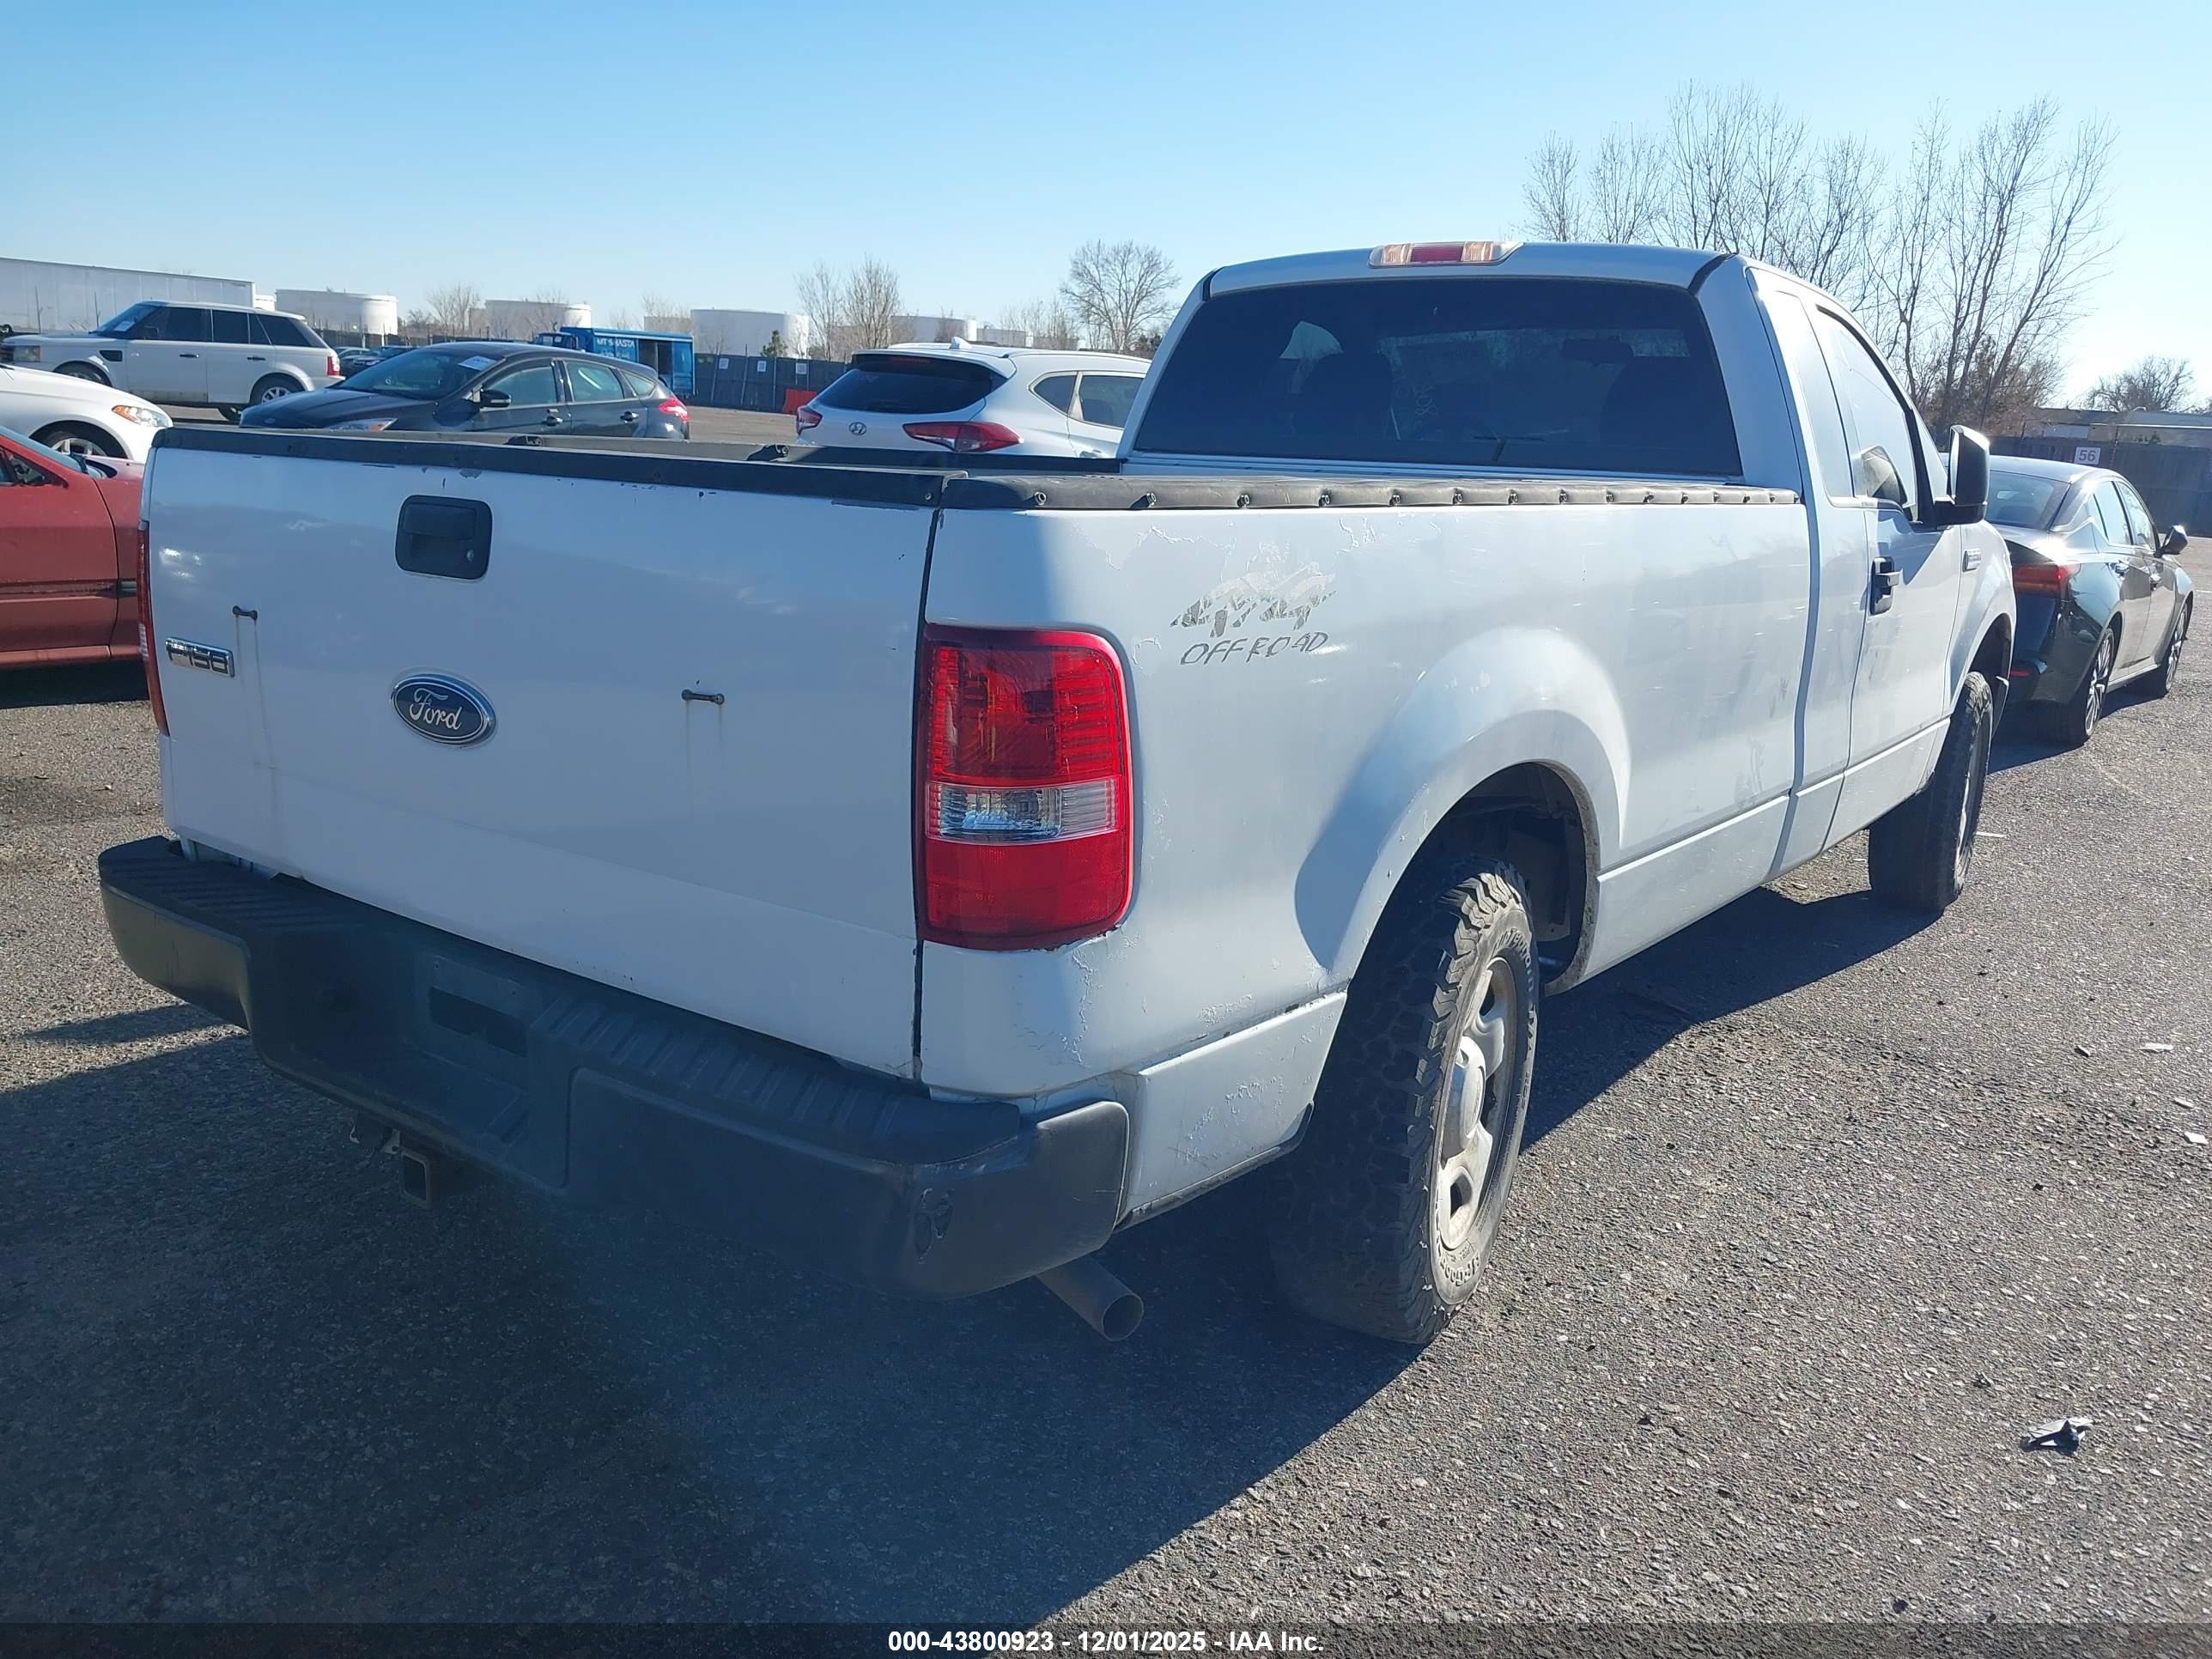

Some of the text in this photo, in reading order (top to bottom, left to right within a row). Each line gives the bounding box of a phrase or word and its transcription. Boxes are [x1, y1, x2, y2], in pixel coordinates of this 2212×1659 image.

[2079, 450, 2096, 461] 56
[1180, 638, 1248, 665] OFF
[409, 688, 462, 730] Ford
